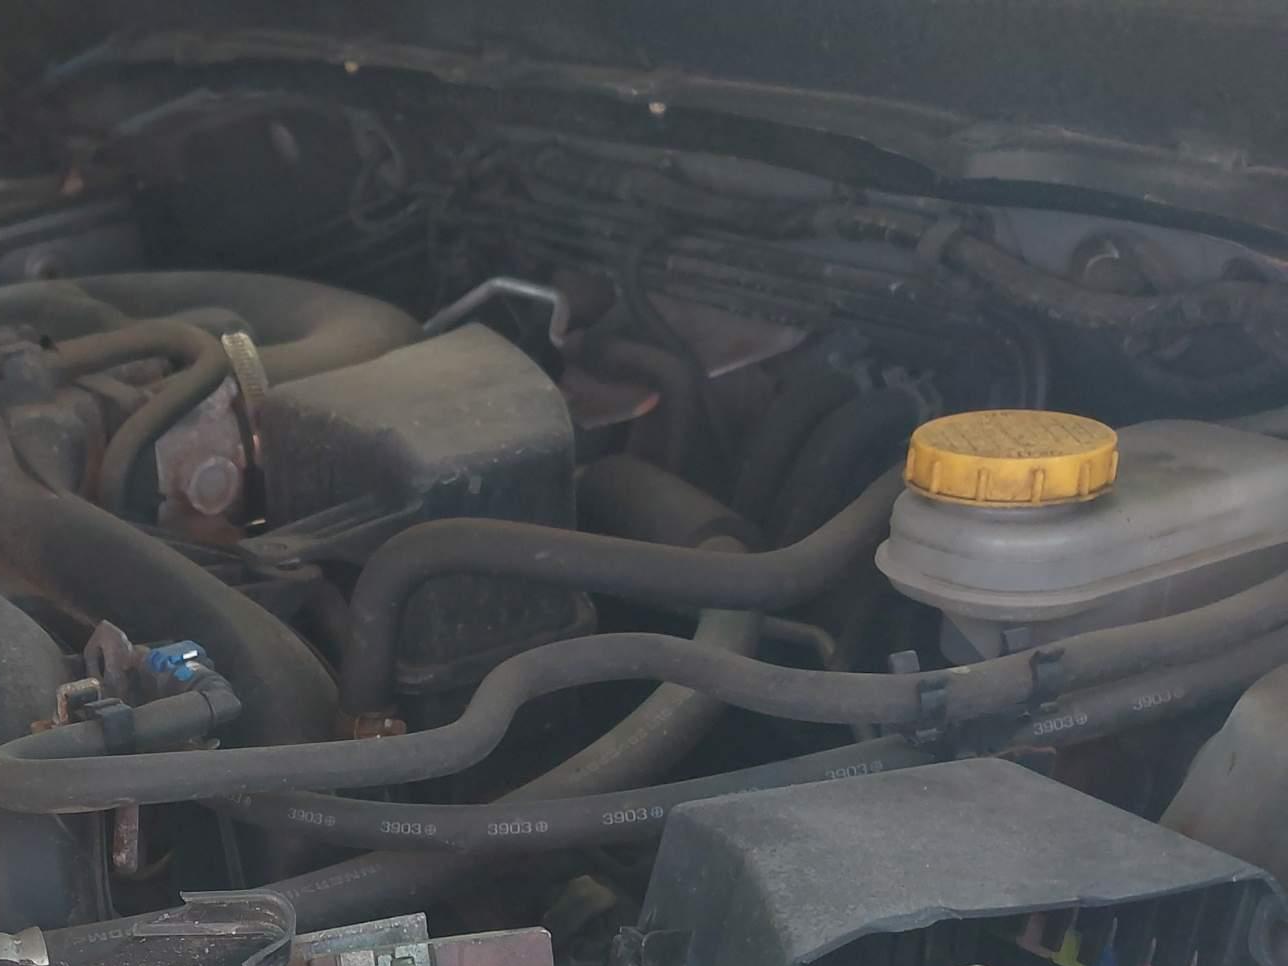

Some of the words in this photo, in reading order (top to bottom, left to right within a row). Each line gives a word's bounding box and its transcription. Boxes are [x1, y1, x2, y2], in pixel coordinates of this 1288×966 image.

[1033, 715, 1073, 736] 3903
[288, 808, 323, 824] 3903
[602, 808, 648, 826] 3903
[381, 820, 421, 835] 3903
[488, 821, 532, 836] 3903
